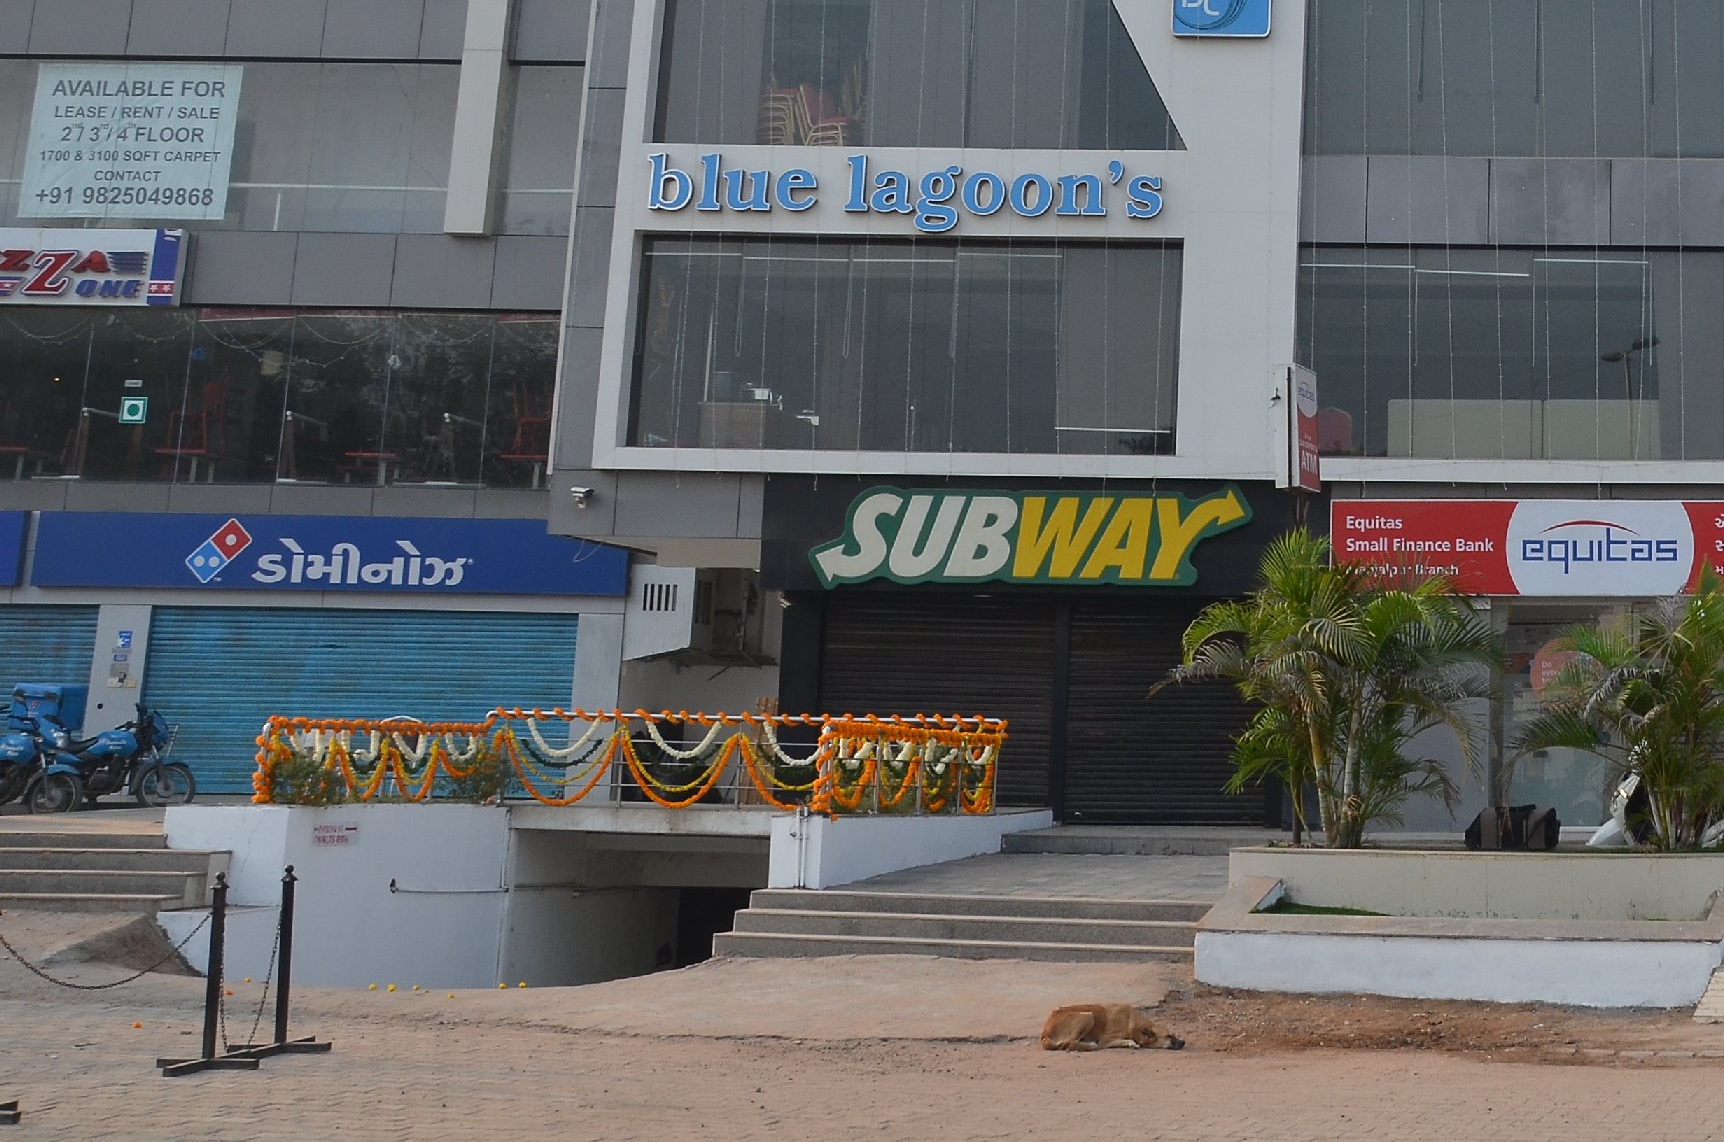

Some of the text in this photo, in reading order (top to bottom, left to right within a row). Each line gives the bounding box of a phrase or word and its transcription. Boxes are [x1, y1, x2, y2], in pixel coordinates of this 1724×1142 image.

[52, 80, 225, 97] AVAILABLE FOR
[54, 106, 107, 118] LEASE
[121, 107, 164, 119] RENT
[177, 107, 220, 119] SALE
[135, 127, 204, 142] FLOOR
[40, 151, 221, 163] 1700 & 3100 SQFT CARPET
[94, 170, 162, 182] CONTACT
[35, 186, 214, 206] +91 9825049868
[648, 154, 1163, 232] blue lagoon's
[1301, 449, 1318, 475] ATM
[1346, 516, 1403, 532] Equitas
[815, 489, 1245, 582] SUBWAY
[1346, 538, 1494, 552] Small Finance Bank
[1522, 527, 1678, 575] equitas
[251, 538, 467, 586] ડોમીનોઝ
